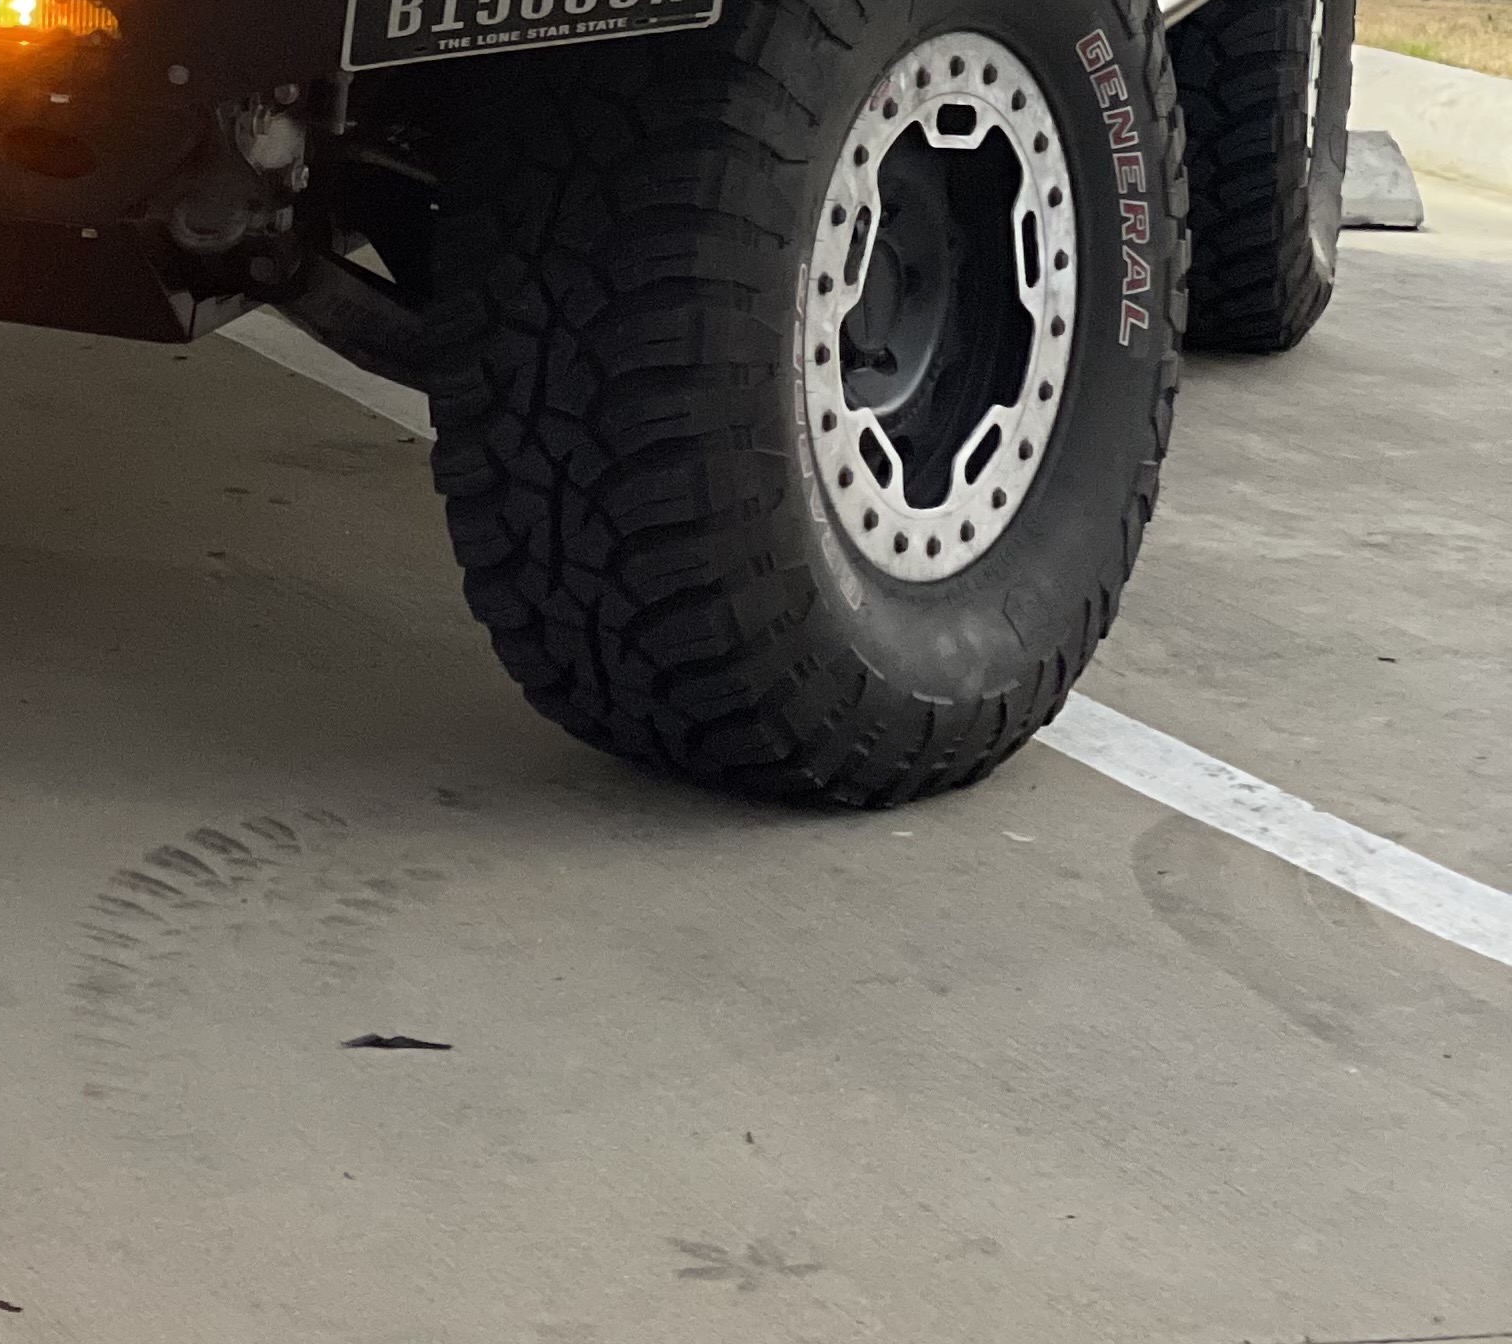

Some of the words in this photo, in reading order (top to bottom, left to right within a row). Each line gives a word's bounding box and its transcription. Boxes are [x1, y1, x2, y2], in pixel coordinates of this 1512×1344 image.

[438, 37, 474, 51] THE
[477, 30, 521, 45] LONE
[527, 24, 570, 40] STAR
[576, 16, 627, 33] STATE
[1075, 28, 1152, 346] GENERAL
